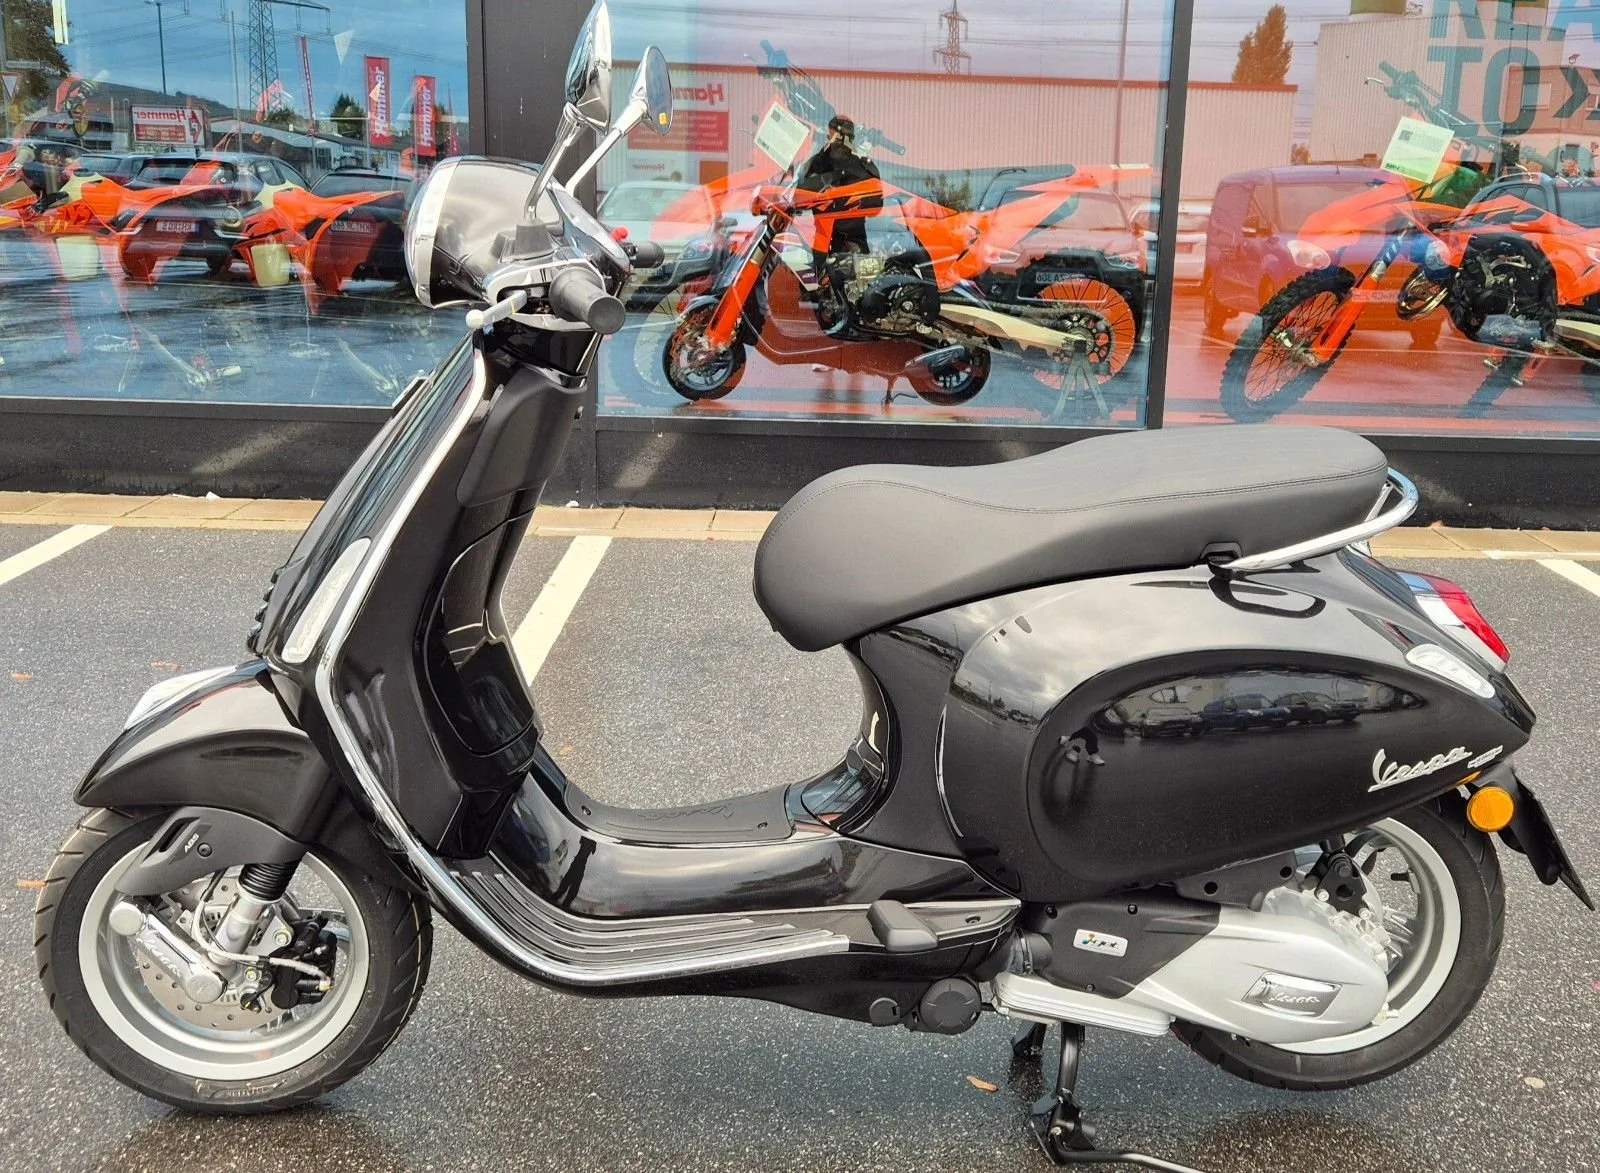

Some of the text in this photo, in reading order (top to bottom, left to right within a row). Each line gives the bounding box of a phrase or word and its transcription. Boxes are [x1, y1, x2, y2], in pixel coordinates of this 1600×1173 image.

[374, 66, 389, 137] Hammer
[419, 86, 434, 147] Hammer
[1367, 747, 1473, 793] Vespa
[184, 833, 200, 853] ABS
